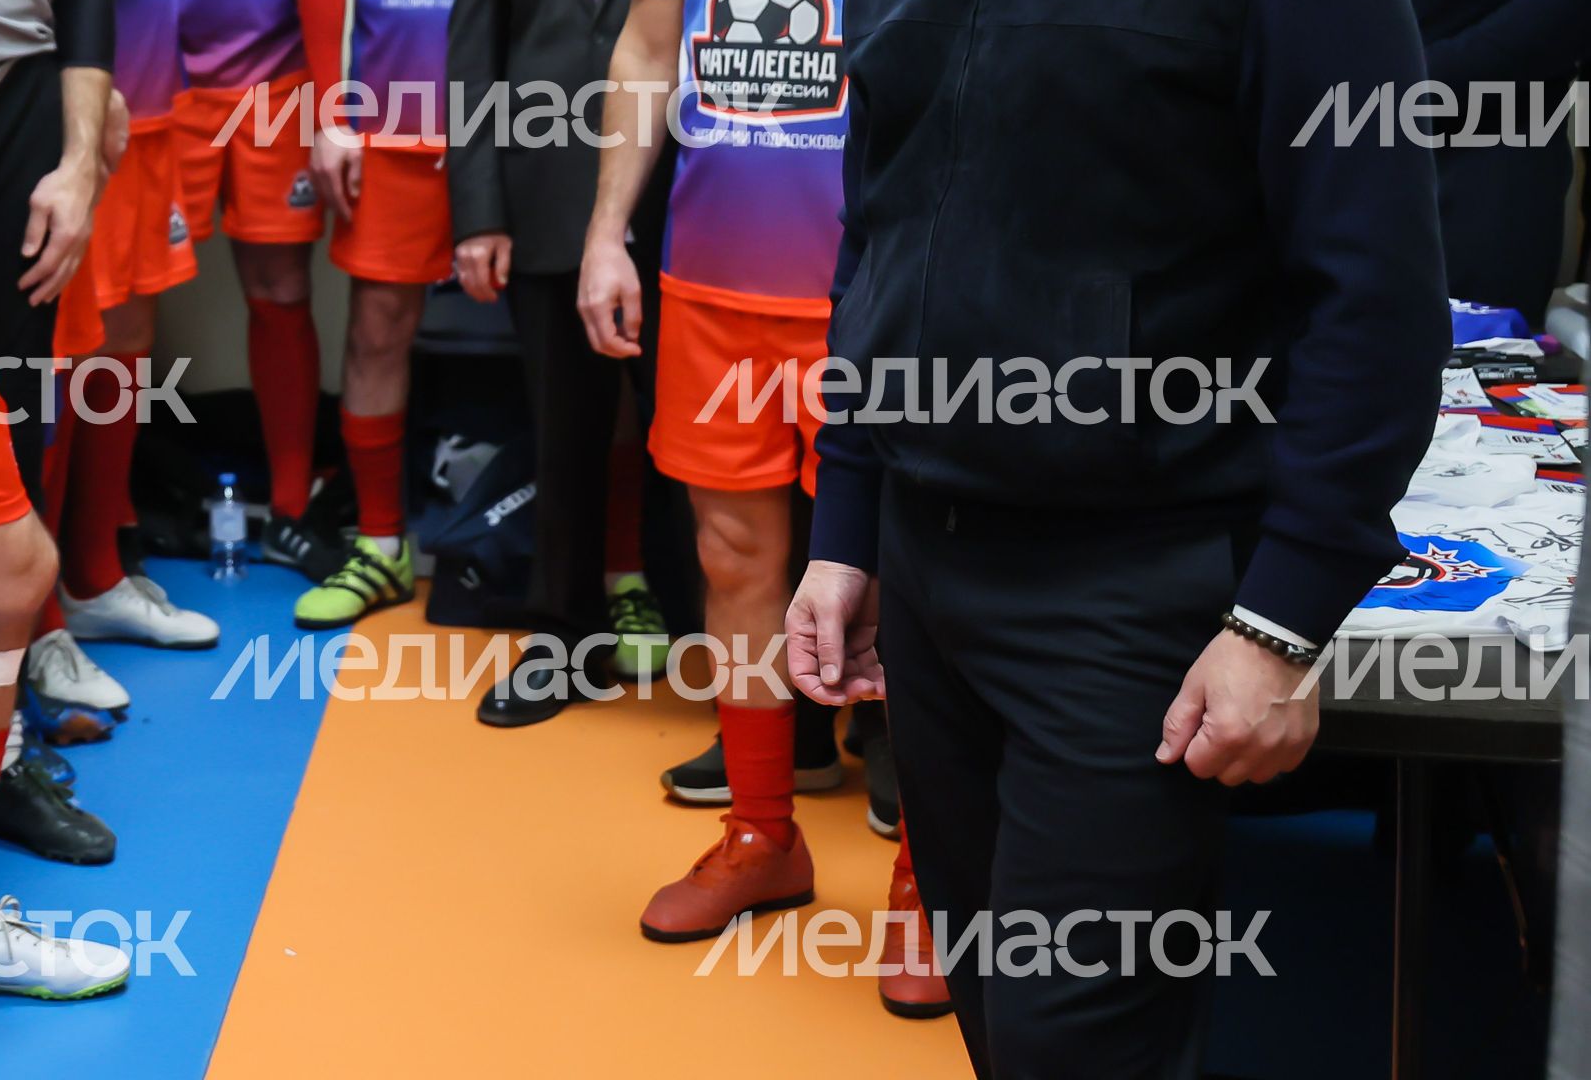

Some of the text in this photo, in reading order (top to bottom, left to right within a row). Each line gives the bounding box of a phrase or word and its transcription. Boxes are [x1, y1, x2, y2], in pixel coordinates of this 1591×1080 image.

[699, 48, 837, 82] МАТЧ ЛЕГЕНД
[761, 82, 828, 99] РОССИИ
